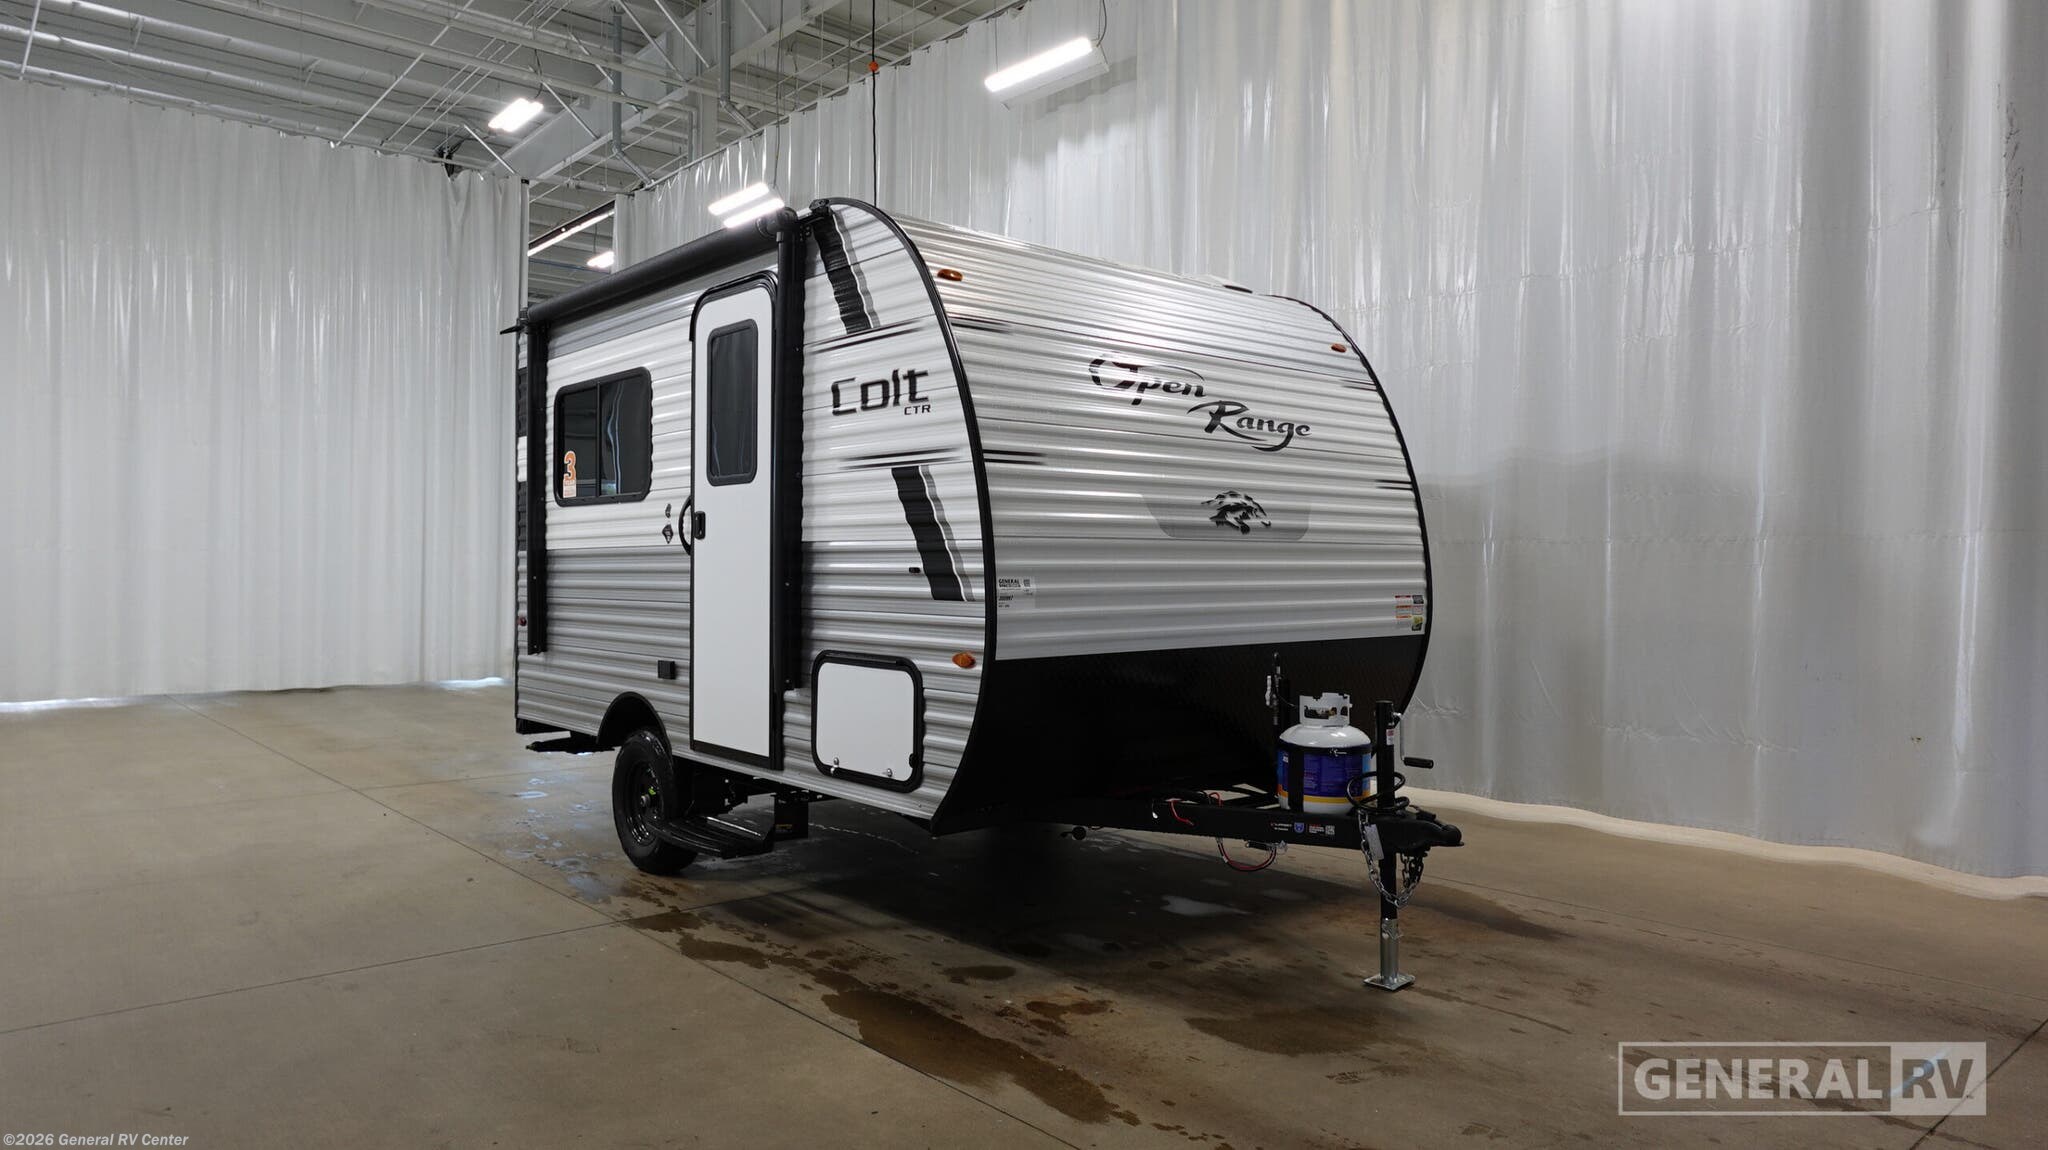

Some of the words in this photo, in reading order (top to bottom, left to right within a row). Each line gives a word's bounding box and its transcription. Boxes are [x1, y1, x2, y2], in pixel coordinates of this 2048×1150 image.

[831, 369, 929, 416] Colt
[1088, 354, 1206, 406] Open
[904, 404, 931, 415] CTR
[1187, 400, 1312, 452] Range
[563, 450, 576, 481] 3
